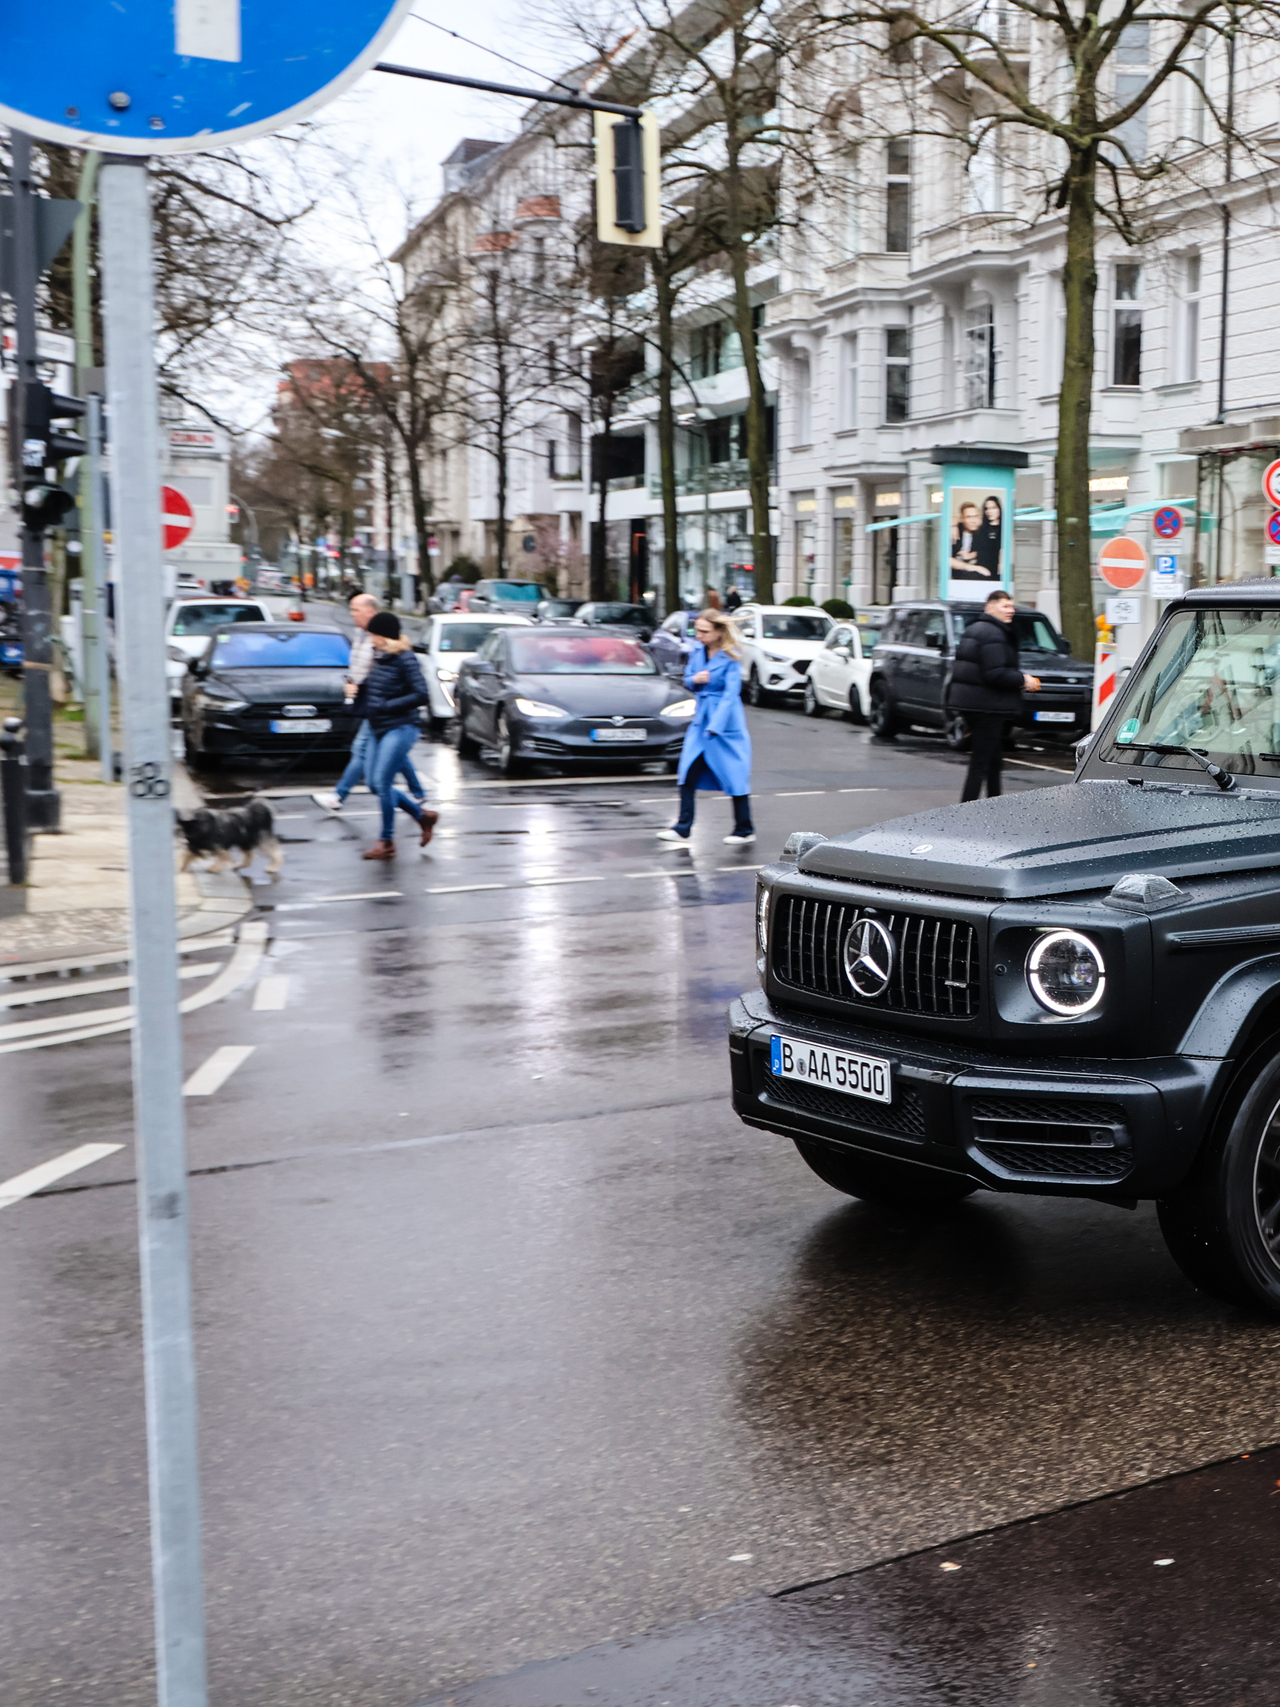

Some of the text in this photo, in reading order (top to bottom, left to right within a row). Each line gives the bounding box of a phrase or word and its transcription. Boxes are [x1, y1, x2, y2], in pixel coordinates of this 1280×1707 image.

[1159, 557, 1173, 572] P
[782, 1042, 885, 1096] B AA 5500
